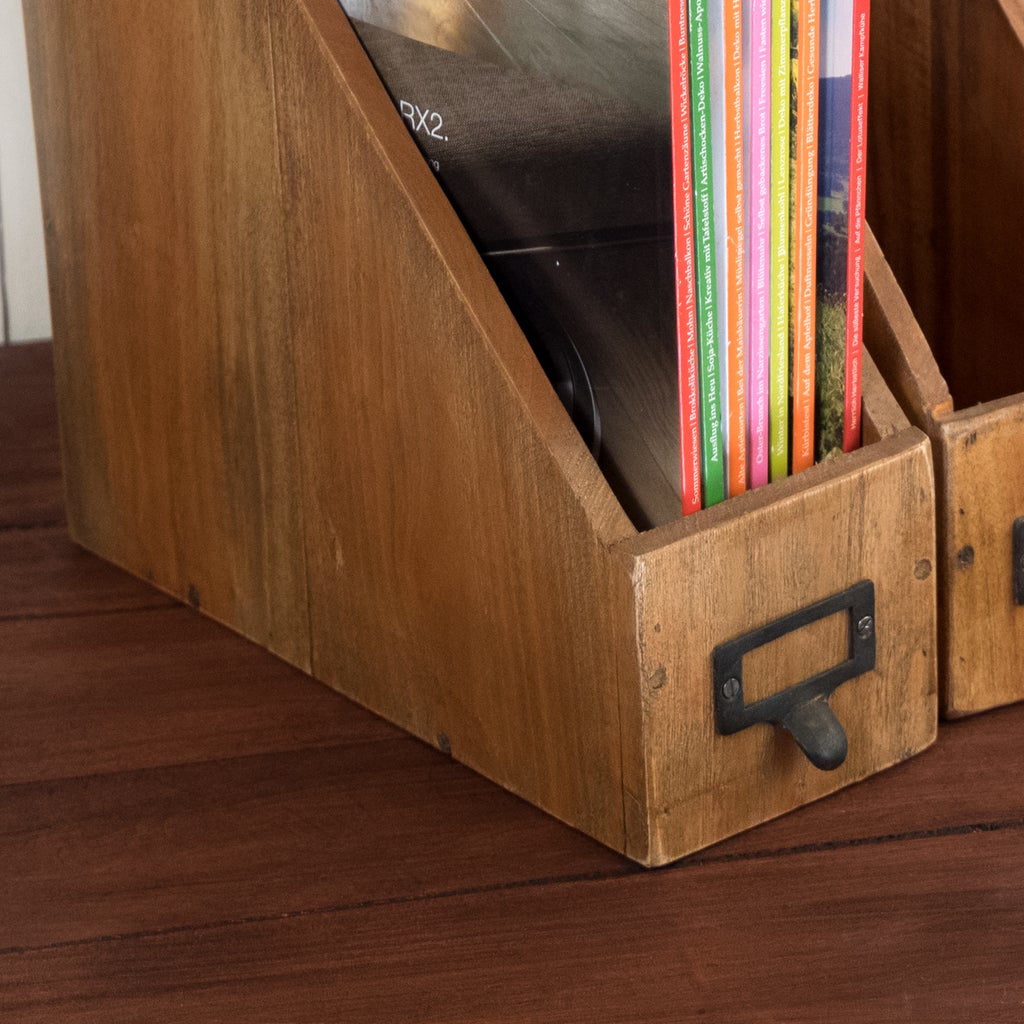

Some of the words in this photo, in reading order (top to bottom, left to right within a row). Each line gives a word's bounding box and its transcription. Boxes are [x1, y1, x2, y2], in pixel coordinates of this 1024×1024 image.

[733, 31, 741, 60] Deko
[759, 17, 768, 52] Fasten
[807, 25, 816, 75] Gesunde
[679, 52, 689, 117] Wickelröcke
[733, 67, 742, 140] Herbstbalkon
[758, 59, 767, 105] Freesien
[399, 99, 449, 142] RX2.
[697, 80, 709, 185] Artischocken-Deko
[758, 111, 767, 135] Brot
[778, 99, 786, 129] Deko
[806, 81, 815, 144] Blätterdeko
[681, 123, 691, 191] Gartenzäune
[734, 147, 743, 191] gemacht
[758, 136, 768, 195] gebackenes
[778, 135, 786, 184] Lenzrose
[682, 192, 692, 230] Schöne
[735, 193, 743, 224] selbst
[758, 197, 766, 230] Selbst
[805, 149, 815, 227] Gründüngung
[701, 192, 711, 241] Tafelstoff
[777, 191, 788, 257] Blumenkohl
[684, 236, 694, 305] Naschbalkon
[704, 265, 713, 303] Kreativ
[757, 237, 766, 289] Blütenuhr
[804, 234, 813, 298] Duftnesseln
[777, 263, 786, 325] Haferküche
[686, 311, 695, 342] Mohn
[705, 310, 717, 373] Soja-Küche
[736, 293, 745, 357] Maisbäuerin
[757, 296, 767, 379] Narzissengarten
[803, 304, 814, 350] Apfelhof
[687, 349, 697, 421] Brokkoliküche
[777, 332, 786, 405] Nordfriesland
[691, 426, 700, 505] Sommerwiesen
[709, 420, 721, 462] Ausflug
